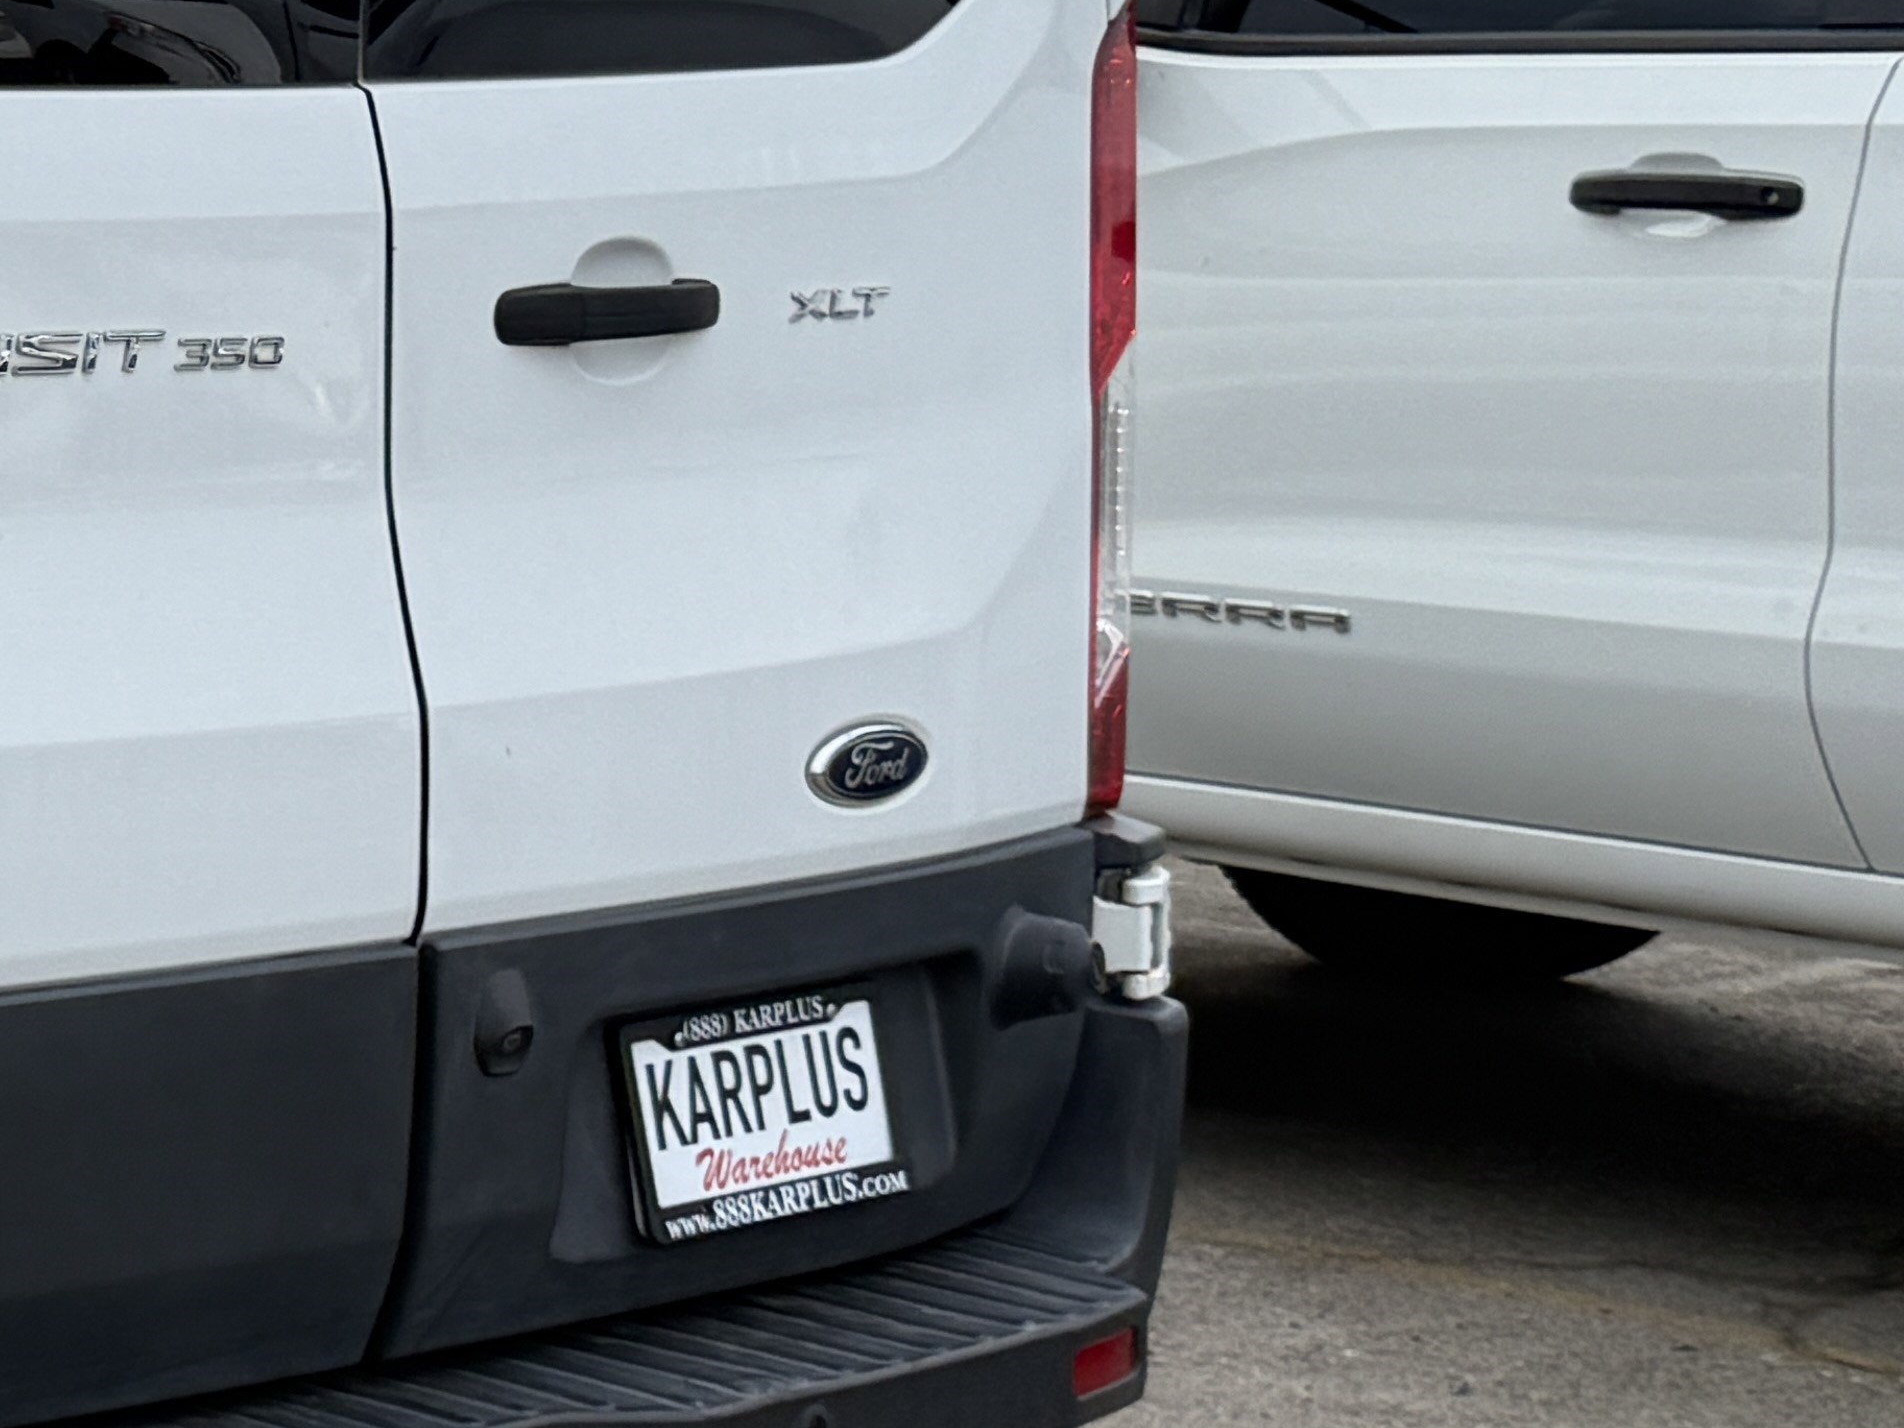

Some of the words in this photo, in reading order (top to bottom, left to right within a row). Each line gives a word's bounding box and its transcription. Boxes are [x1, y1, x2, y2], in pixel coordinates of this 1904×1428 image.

[789, 286, 891, 323] XLT
[174, 334, 286, 373] 350
[1129, 589, 1352, 634] ERRA
[844, 740, 910, 789] Ford
[681, 1014, 729, 1042] (888)
[733, 995, 824, 1032] KARPLUS
[646, 1027, 870, 1151] KARPLUS
[695, 1129, 848, 1192] Warehouse
